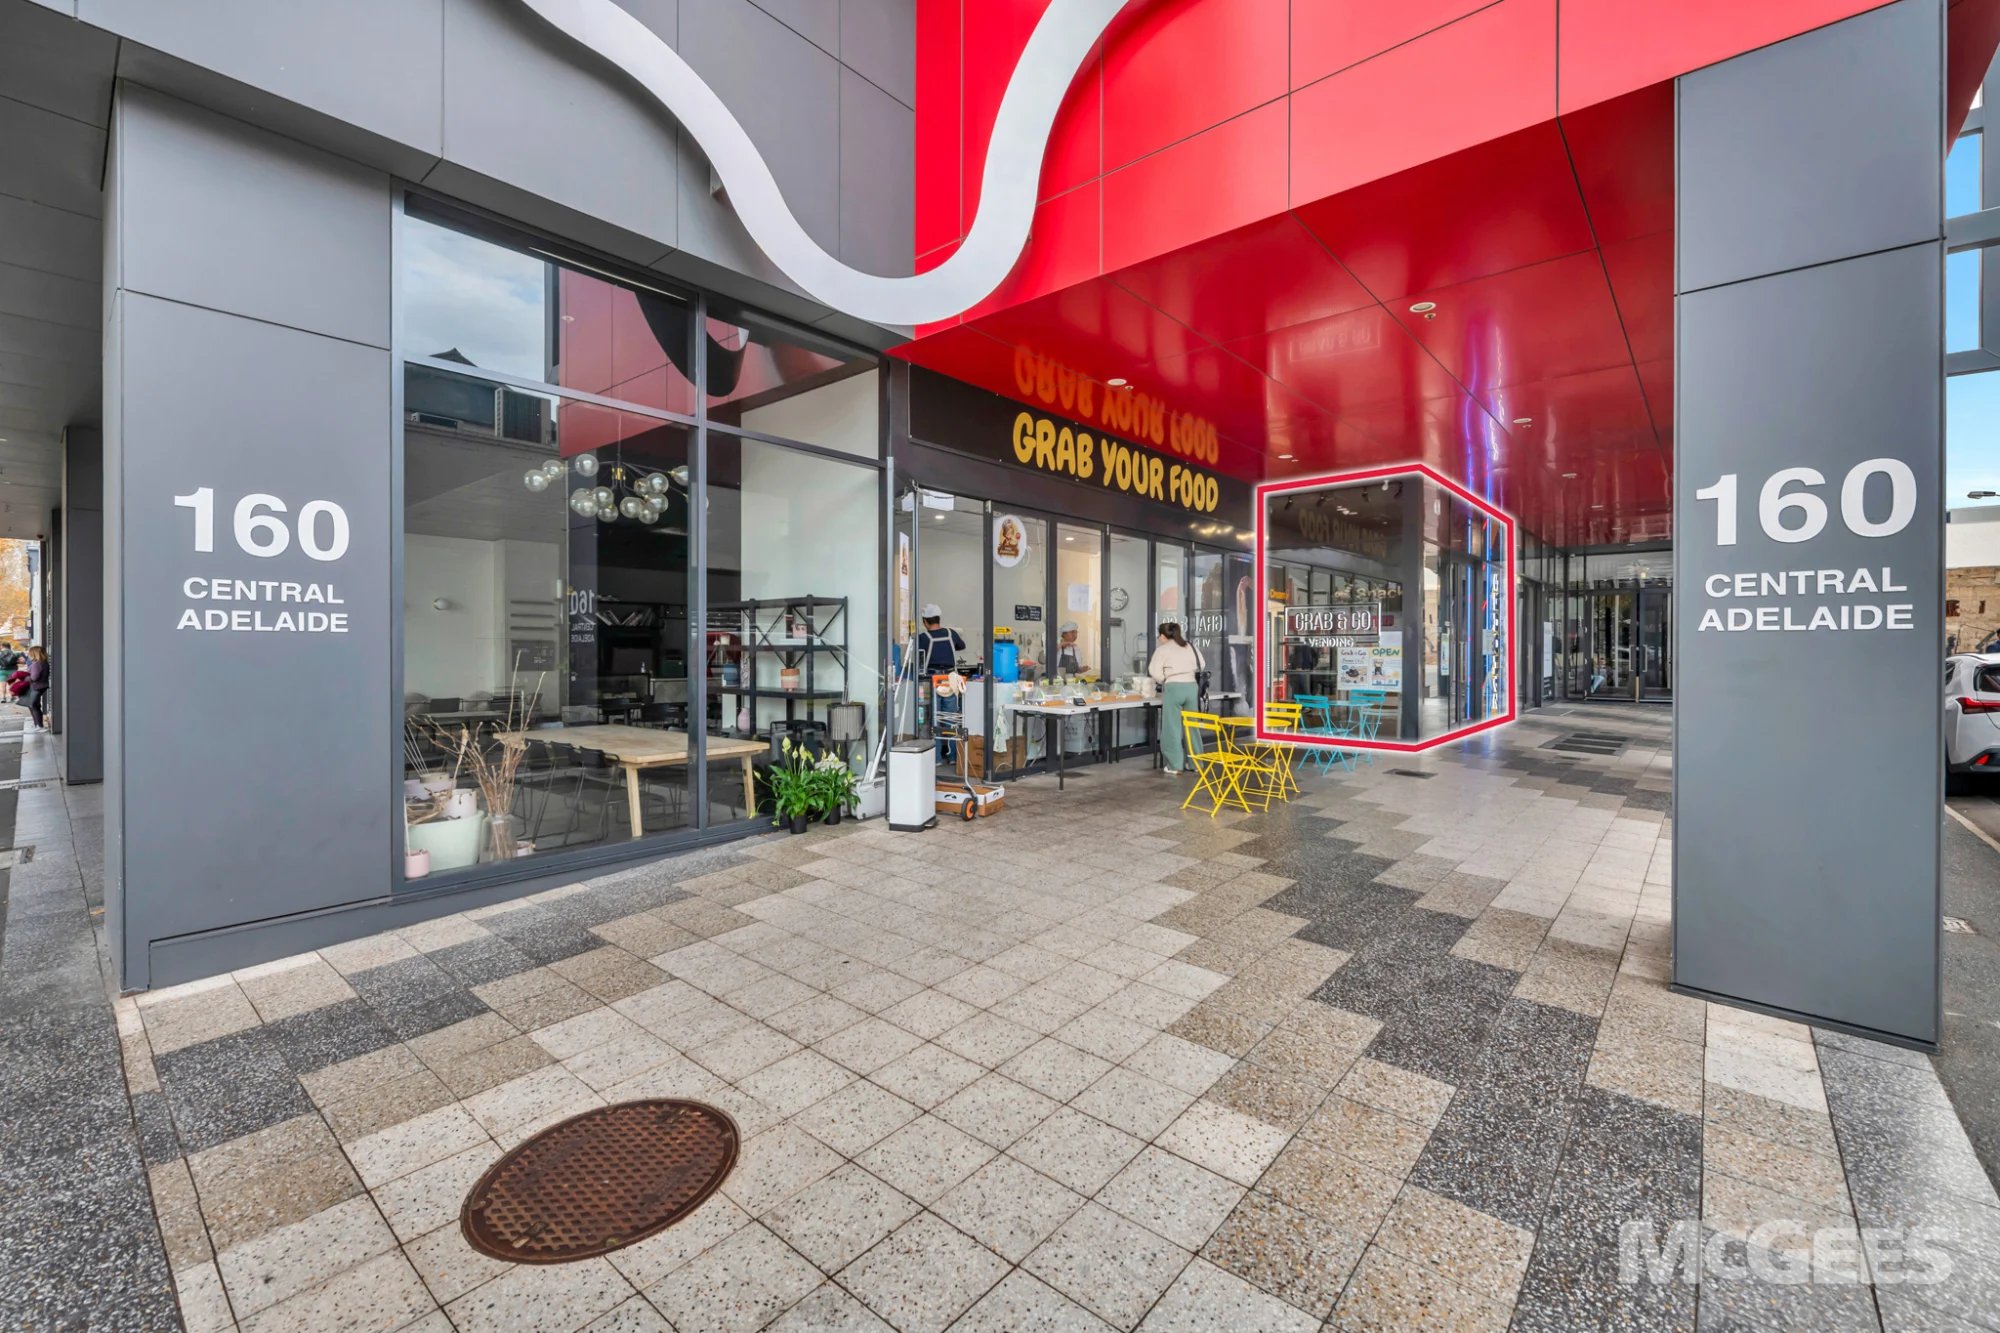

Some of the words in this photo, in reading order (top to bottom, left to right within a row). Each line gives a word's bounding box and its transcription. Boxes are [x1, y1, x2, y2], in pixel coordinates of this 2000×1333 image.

[1012, 411, 1094, 479] GRAB
[1101, 438, 1165, 501] YOUR
[1169, 465, 1219, 512] FOOD
[1695, 457, 1918, 546] 160
[174, 486, 350, 562] 160
[183, 576, 345, 604] CENTRAL
[1704, 566, 1908, 598] CENTRAL
[176, 608, 349, 633] ADELAIDE
[1295, 611, 1333, 632] GRAB
[1337, 611, 1348, 631] &
[1351, 610, 1372, 631] GO
[1697, 603, 1914, 632] ADELAIDE
[1308, 636, 1355, 648] VENDING
[1372, 647, 1401, 657] OPEN
